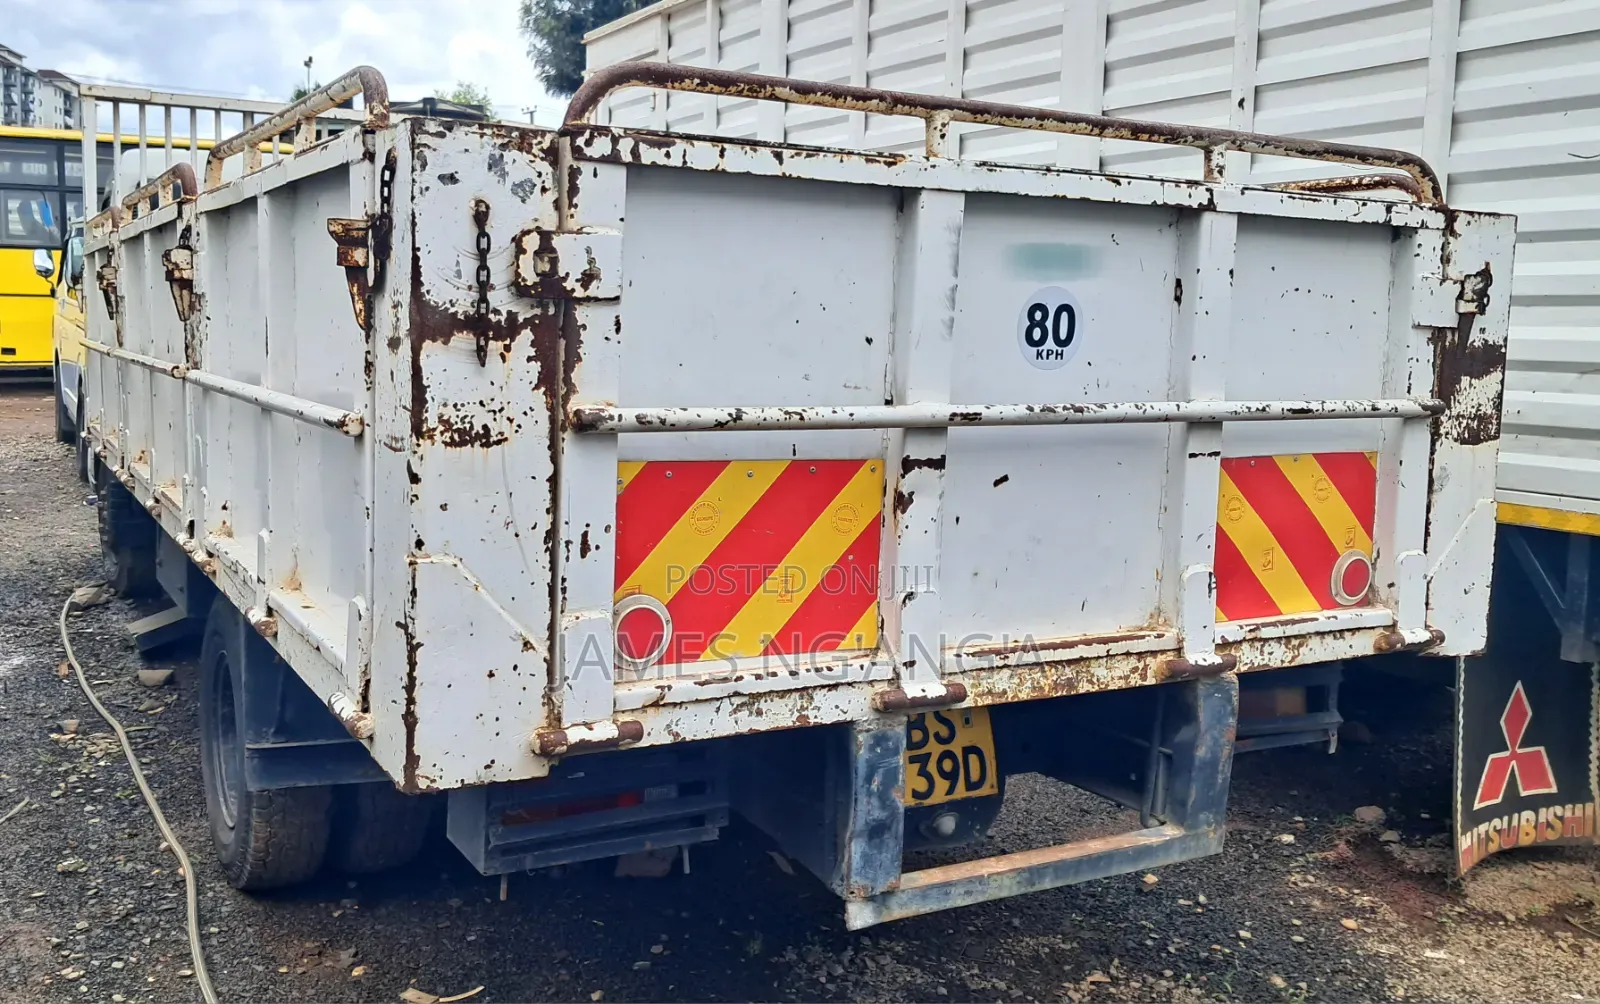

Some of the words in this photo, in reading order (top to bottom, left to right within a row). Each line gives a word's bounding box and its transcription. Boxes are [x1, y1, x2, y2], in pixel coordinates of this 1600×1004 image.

[1025, 303, 1076, 348] 80
[1036, 349, 1064, 360] KPH
[908, 745, 987, 800] 39D
[1461, 803, 1595, 874] MITSUBISHI
